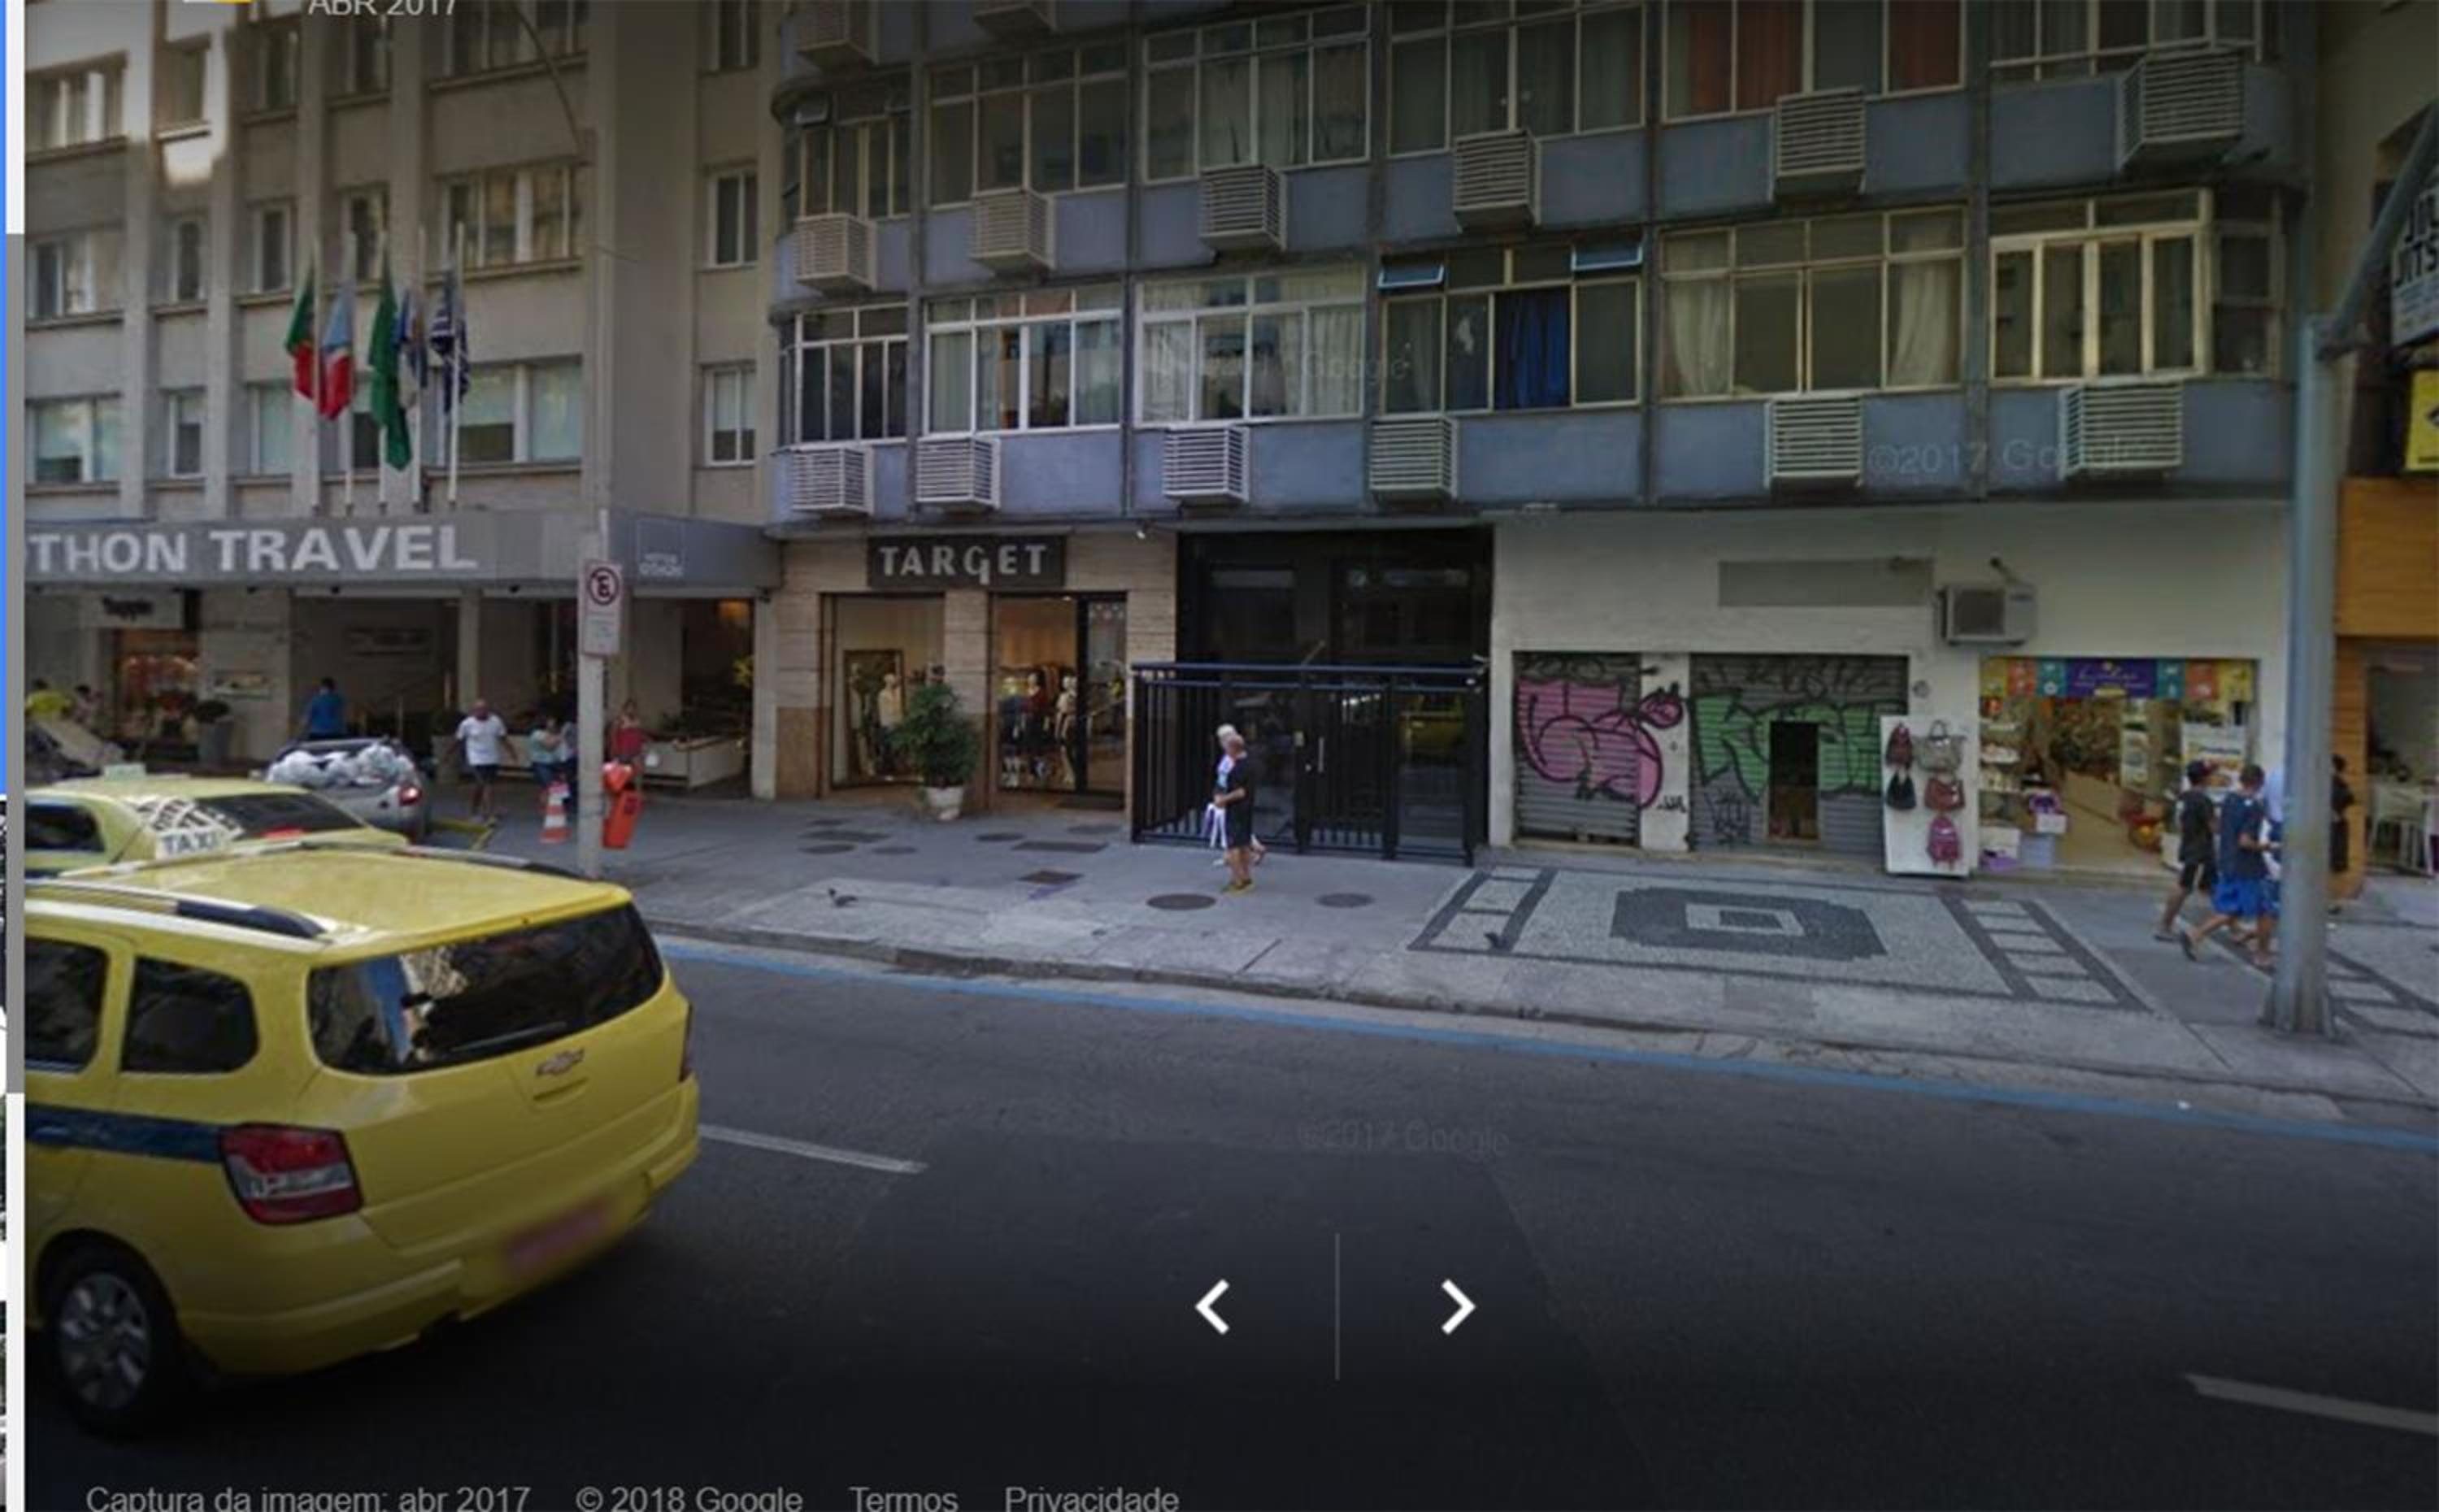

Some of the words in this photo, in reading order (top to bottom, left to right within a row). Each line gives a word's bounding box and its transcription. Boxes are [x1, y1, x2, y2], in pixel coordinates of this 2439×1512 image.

[26, 532, 186, 572] THON
[209, 525, 478, 572] TRAVEL
[879, 545, 1047, 585] TARGET
[163, 831, 220, 855] TAXI
